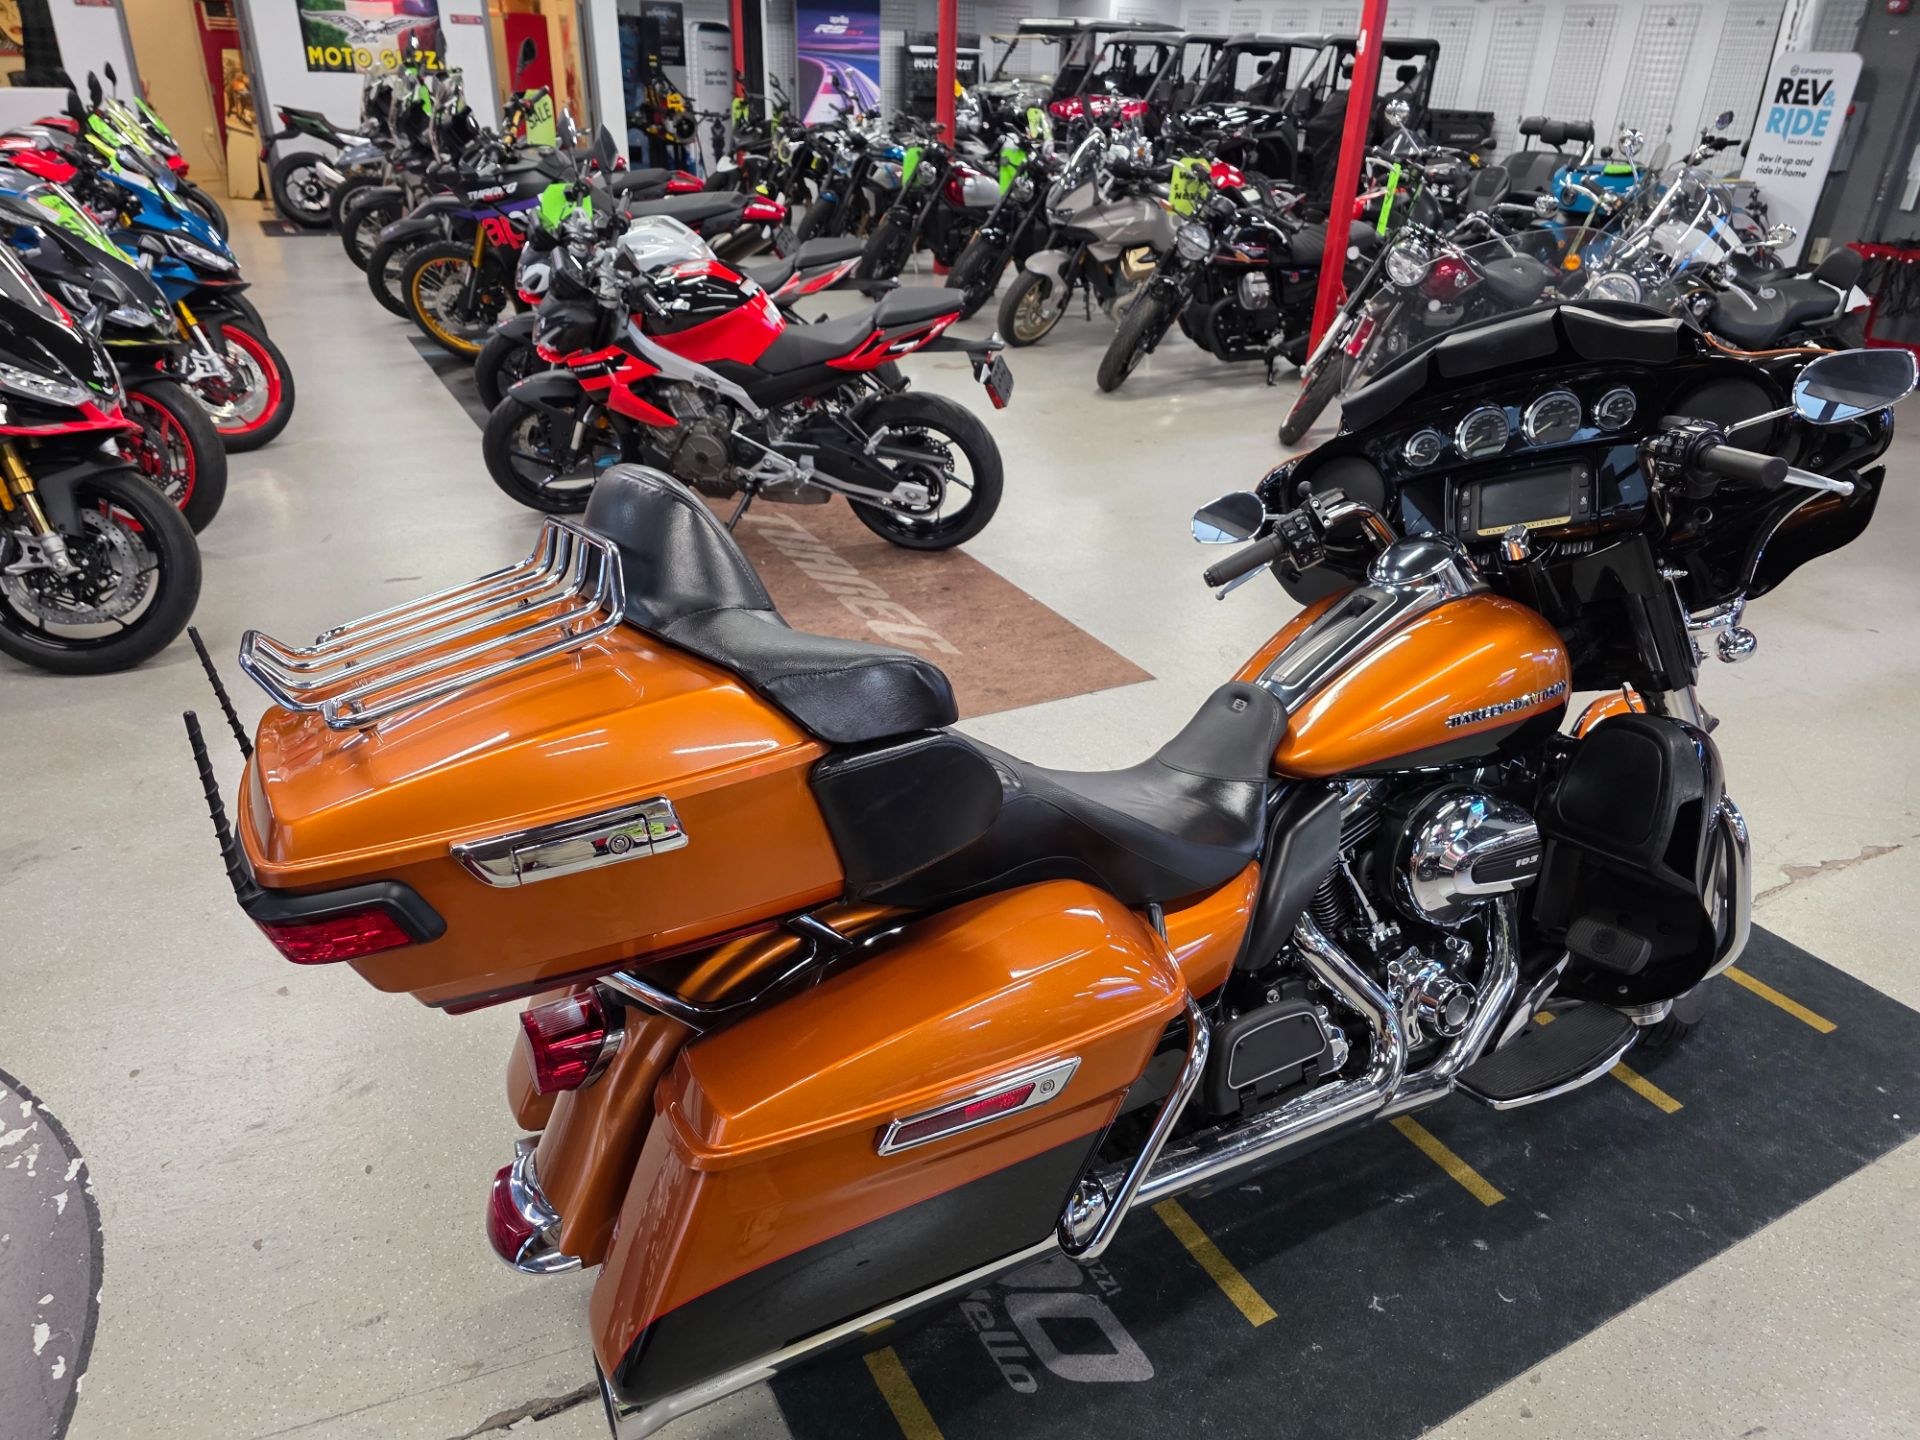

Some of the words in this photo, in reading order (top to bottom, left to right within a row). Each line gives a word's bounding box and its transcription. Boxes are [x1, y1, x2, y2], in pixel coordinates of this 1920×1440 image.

[307, 46, 372, 68] MOTO
[1774, 77, 1834, 106] REV
[528, 102, 552, 129] SALE
[1765, 106, 1832, 141] RIDE
[1756, 165, 1773, 175] ride
[1782, 168, 1807, 178] home
[1758, 153, 1774, 162] Rev
[1782, 157, 1794, 168] up
[1795, 158, 1814, 167] and
